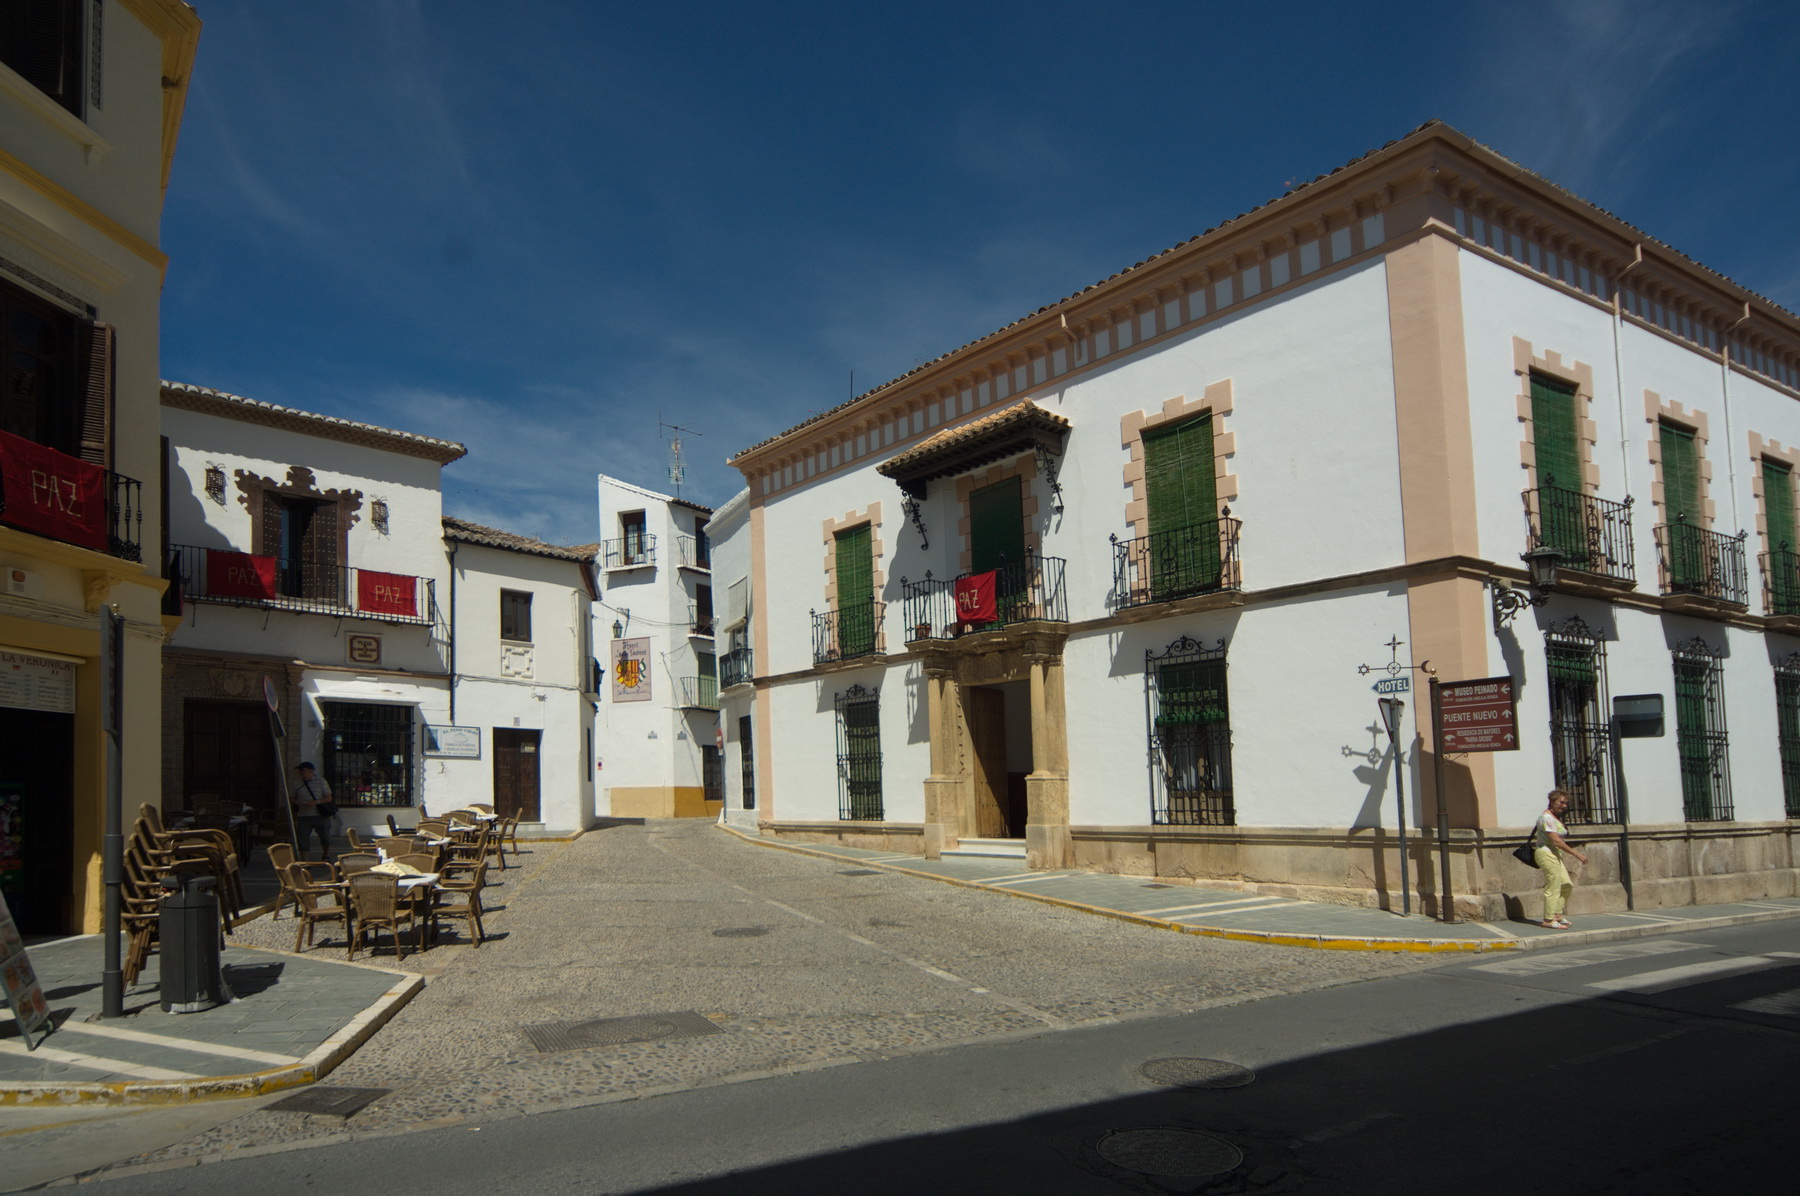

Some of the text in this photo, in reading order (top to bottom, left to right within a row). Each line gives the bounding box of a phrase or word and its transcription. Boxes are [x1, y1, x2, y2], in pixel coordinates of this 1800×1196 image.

[32, 469, 81, 517] PAZ
[228, 566, 259, 586] PAZ
[375, 585, 402, 604] PAZ
[959, 589, 980, 611] PAZ
[2, 653, 16, 663] LA
[1377, 680, 1409, 693] HOTEL
[1454, 683, 1498, 697] MUSEO PEINADO
[1443, 710, 1498, 723] PUENTE NUEVO
